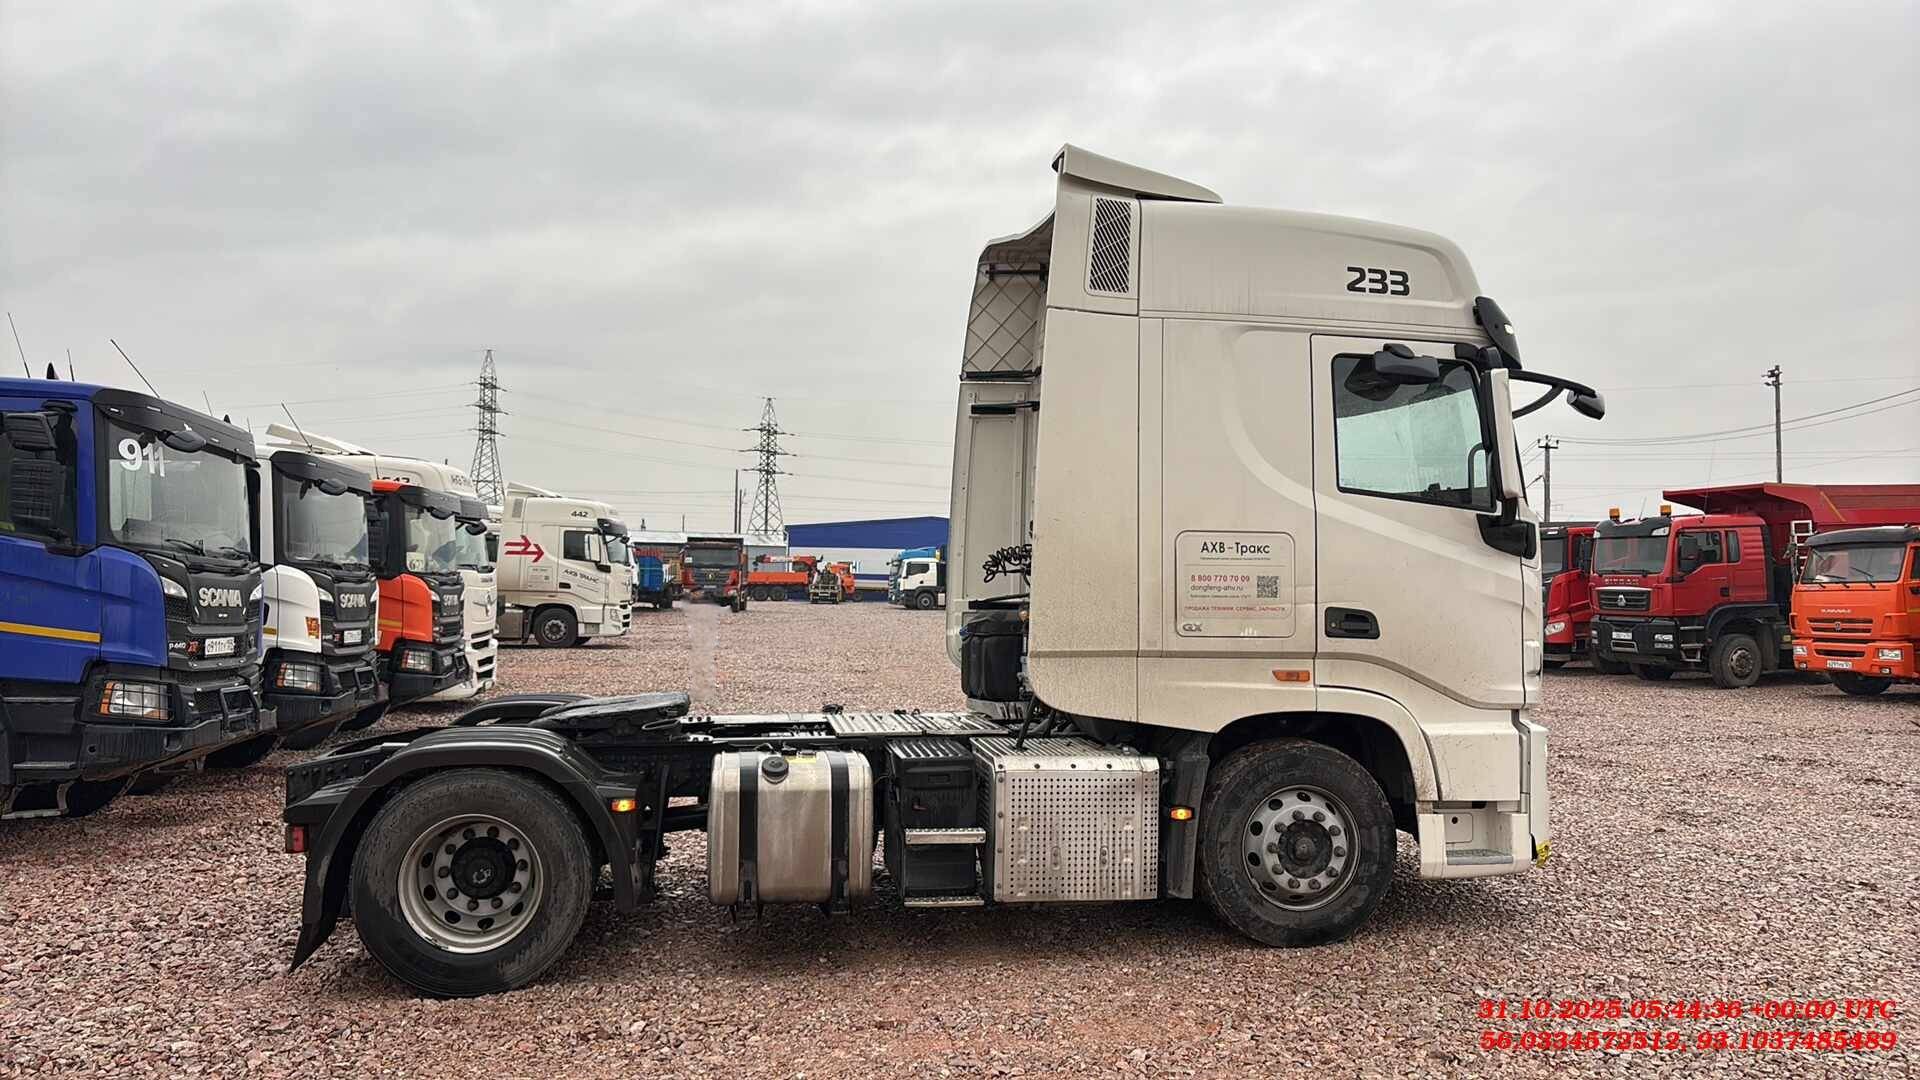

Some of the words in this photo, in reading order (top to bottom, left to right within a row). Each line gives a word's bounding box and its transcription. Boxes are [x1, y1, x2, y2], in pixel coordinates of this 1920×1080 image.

[1346, 266, 1410, 296] 233
[118, 438, 166, 477] 911
[571, 510, 588, 518] 442
[198, 587, 242, 607] SCANIA
